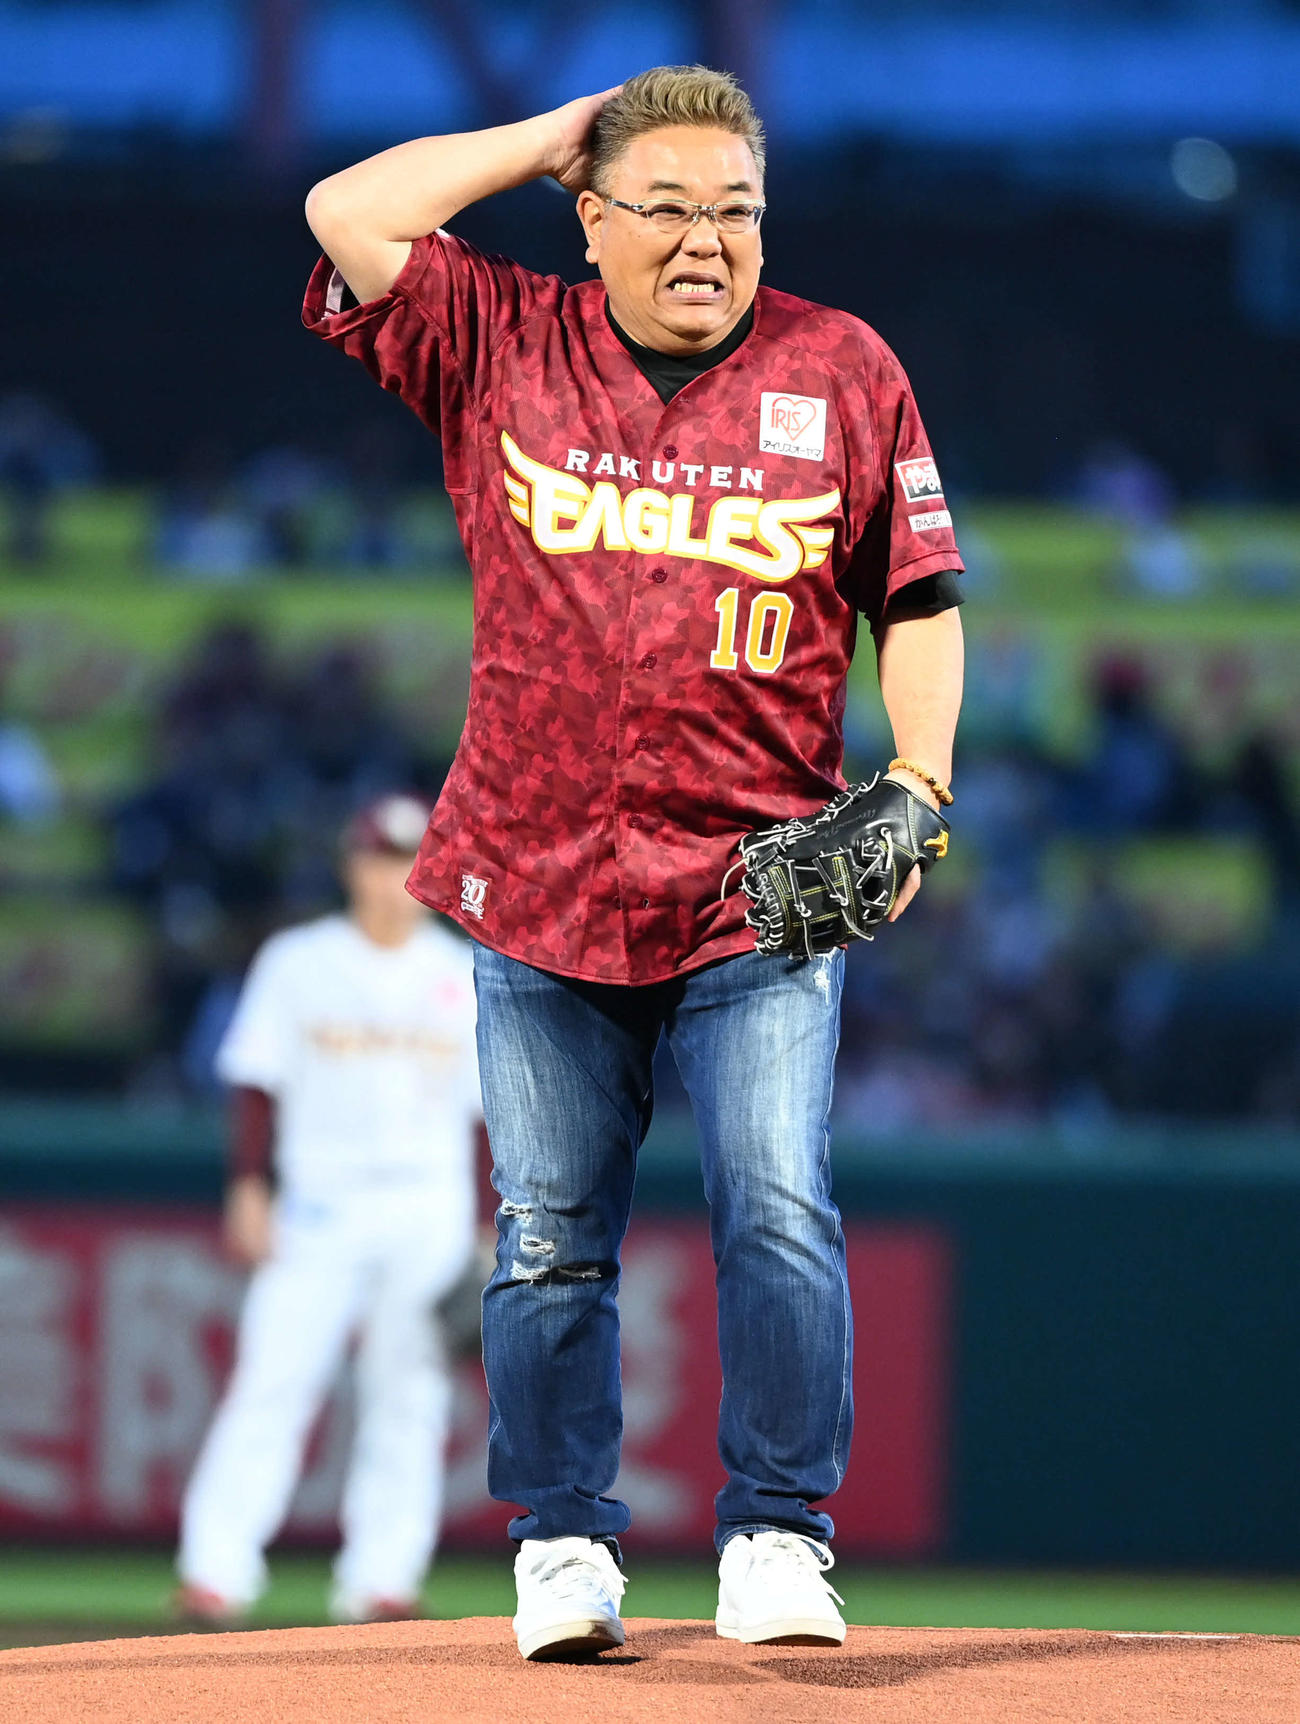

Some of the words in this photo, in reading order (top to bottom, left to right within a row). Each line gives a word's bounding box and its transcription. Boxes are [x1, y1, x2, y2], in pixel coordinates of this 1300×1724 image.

[771, 407, 801, 431] IRIS
[564, 448, 764, 491] RAKUTEN
[501, 429, 840, 582] EAGLES
[709, 586, 794, 674] 10
